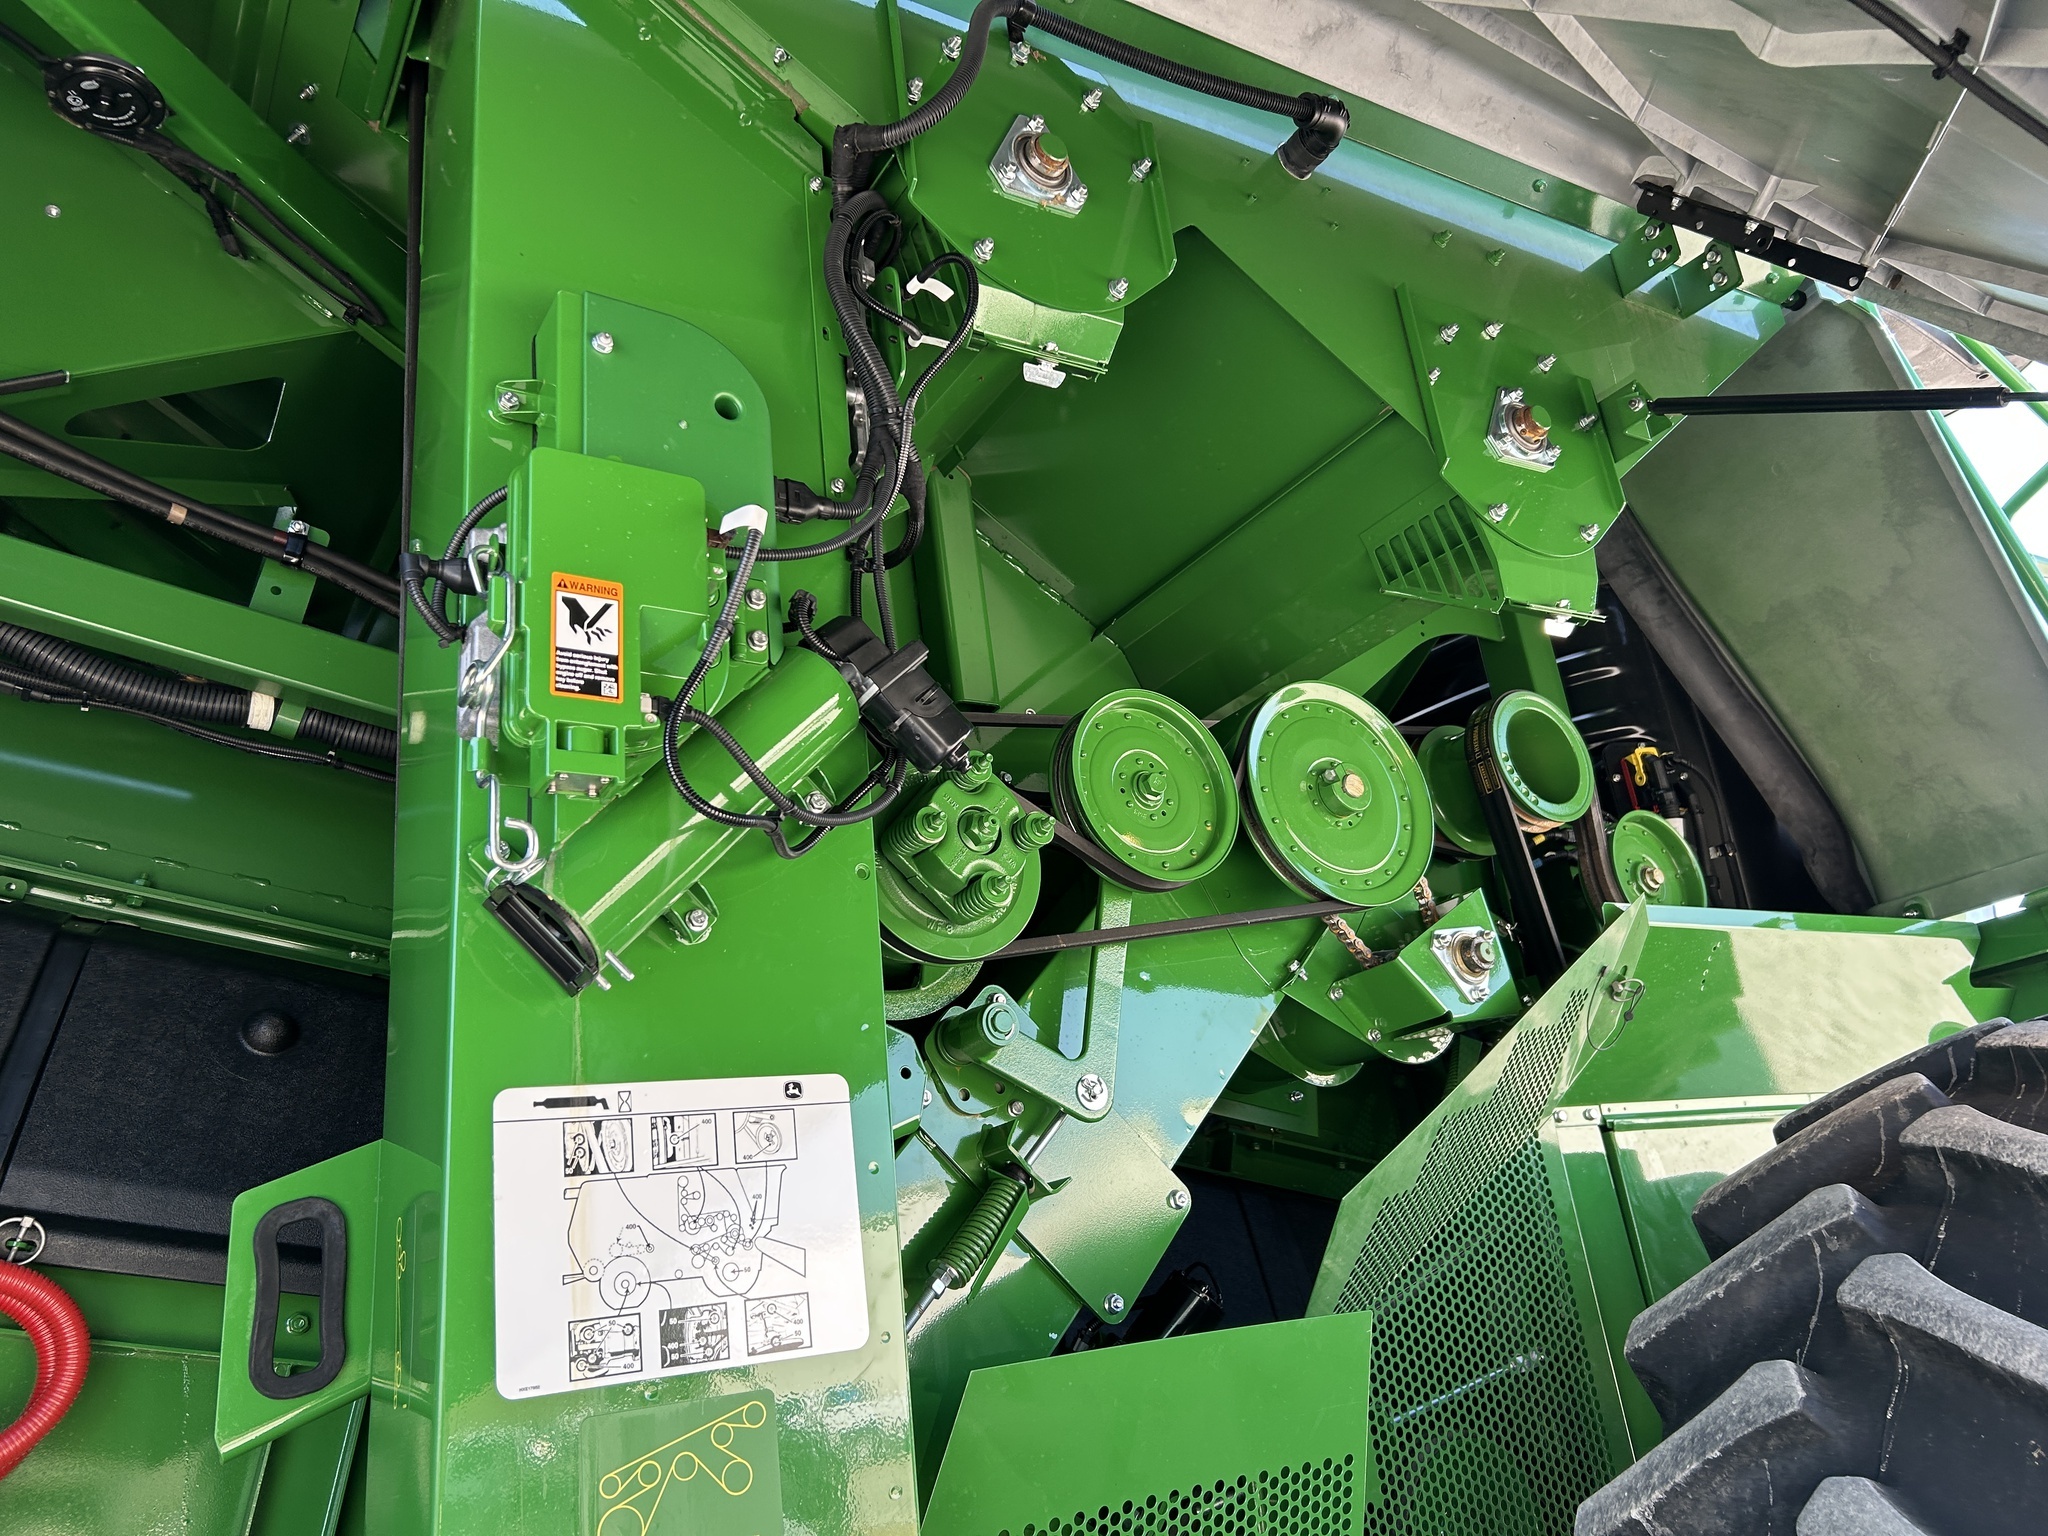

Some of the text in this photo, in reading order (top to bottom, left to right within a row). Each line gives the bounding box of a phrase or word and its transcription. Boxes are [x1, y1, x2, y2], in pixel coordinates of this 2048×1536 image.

[569, 580, 618, 597] WARNING
[556, 649, 572, 657] Avoid
[594, 655, 610, 664] injury
[622, 1362, 635, 1370] 400
